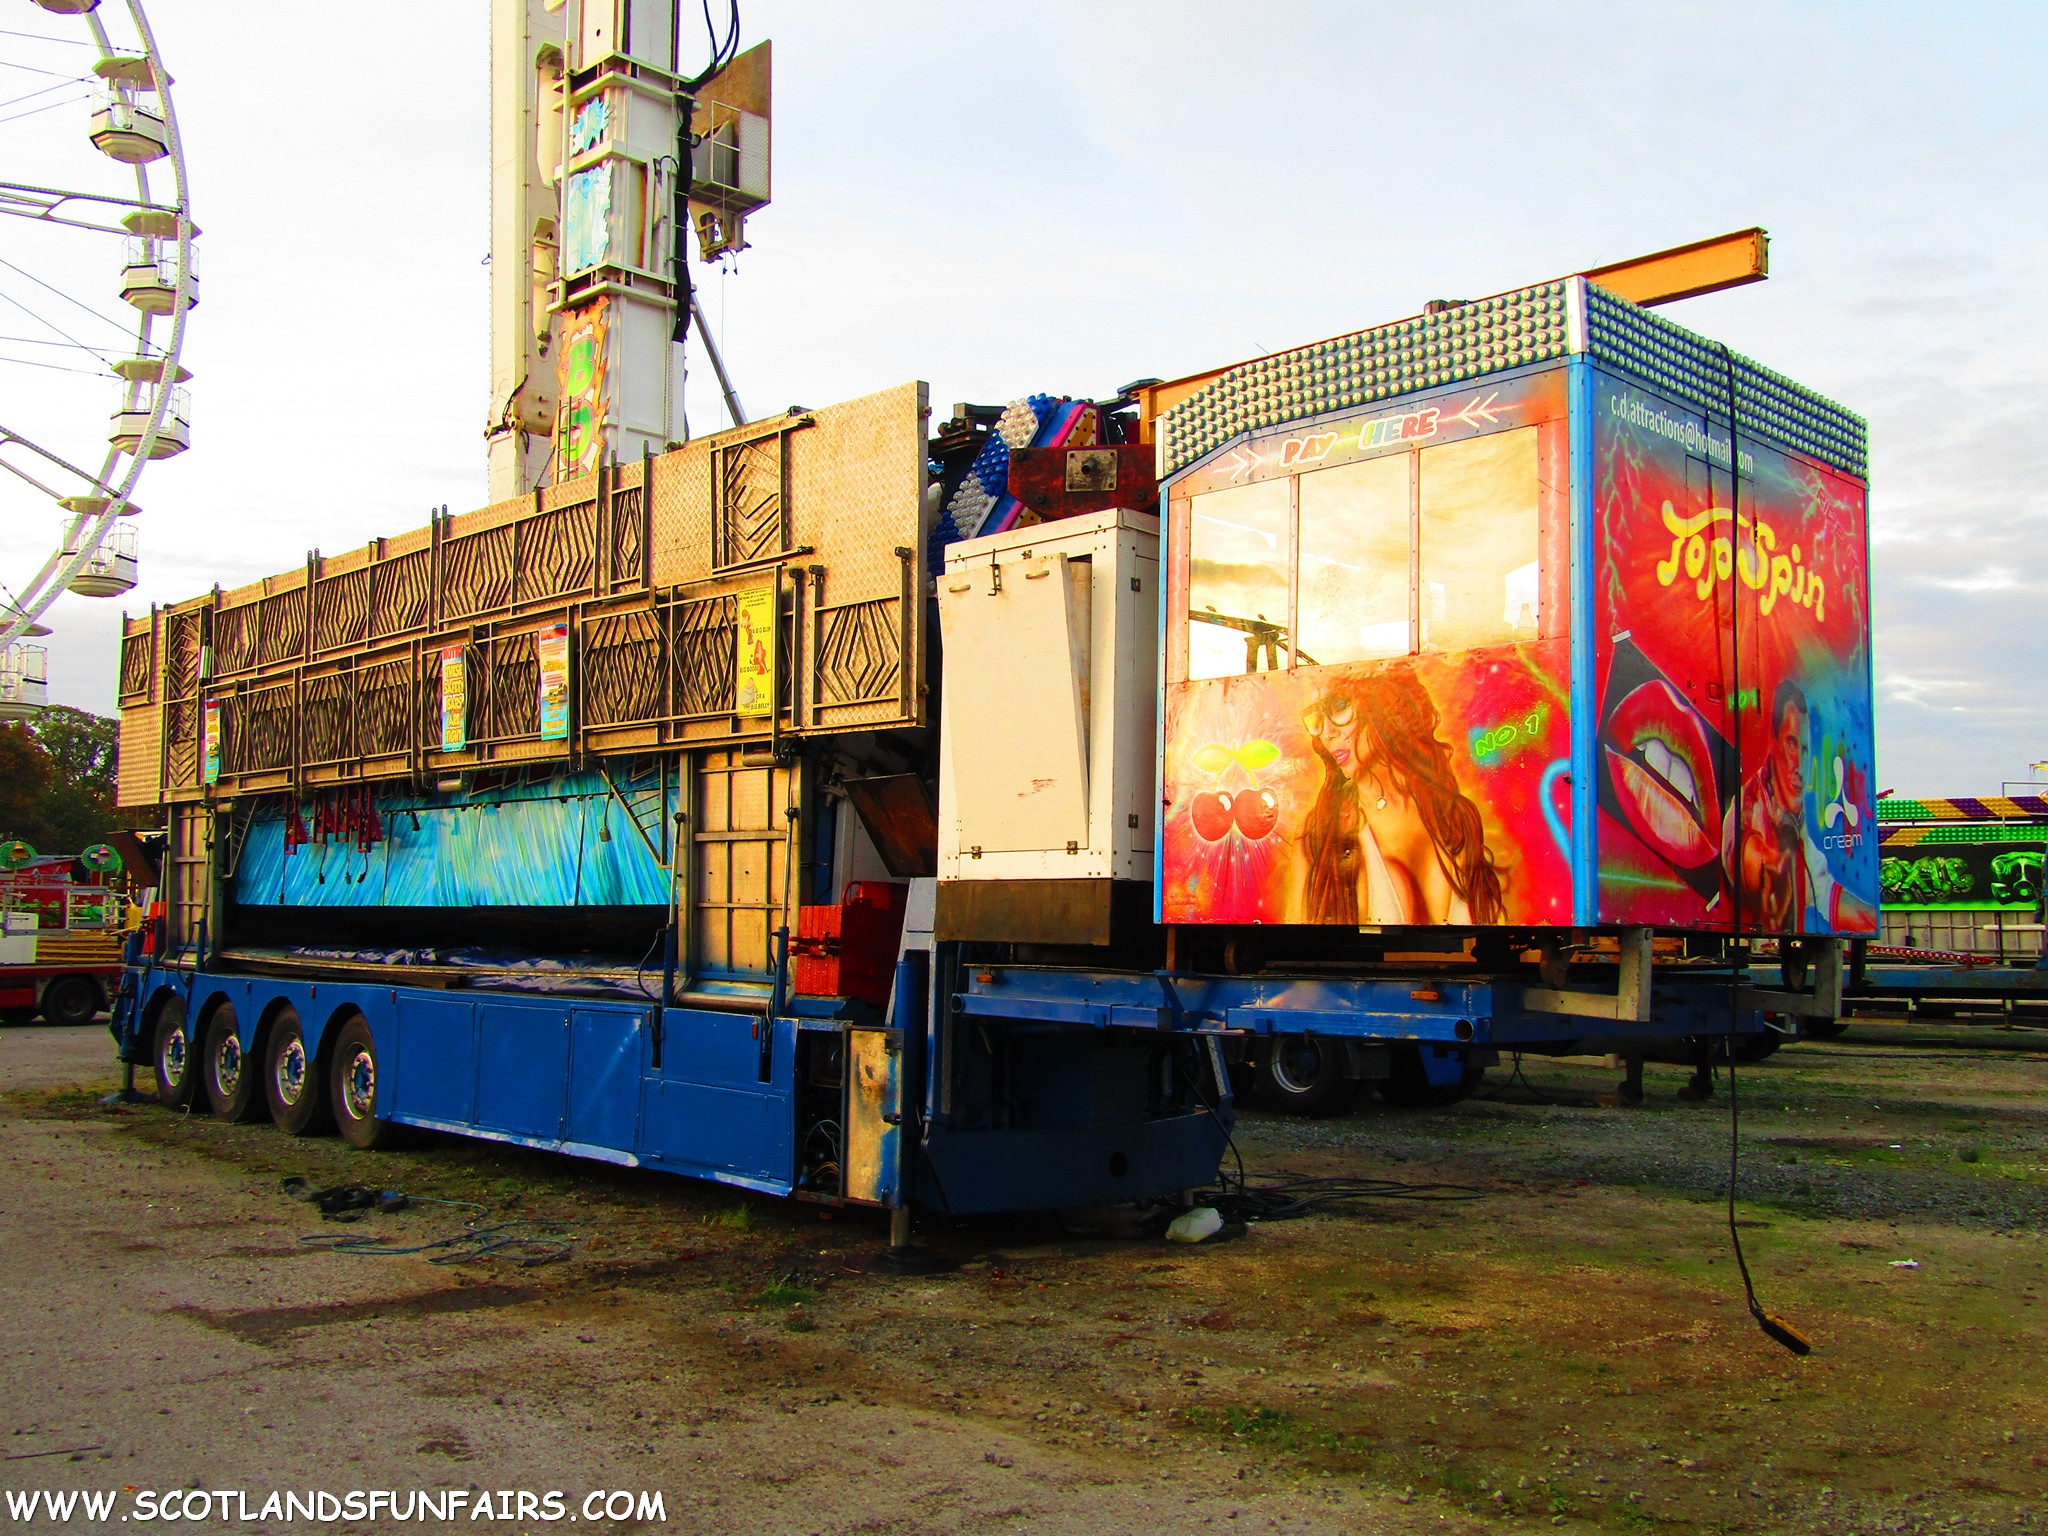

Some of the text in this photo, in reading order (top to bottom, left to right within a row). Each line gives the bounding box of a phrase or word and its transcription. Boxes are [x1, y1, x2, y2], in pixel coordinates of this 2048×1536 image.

[1280, 408, 1440, 466] PAY HERE
[1611, 391, 1753, 474] c.d.attractions@hotmailom
[1657, 500, 1750, 601] Top
[1737, 521, 1825, 622] Spin
[1475, 714, 1539, 756] NO 1
[1823, 833, 1863, 851] cream
